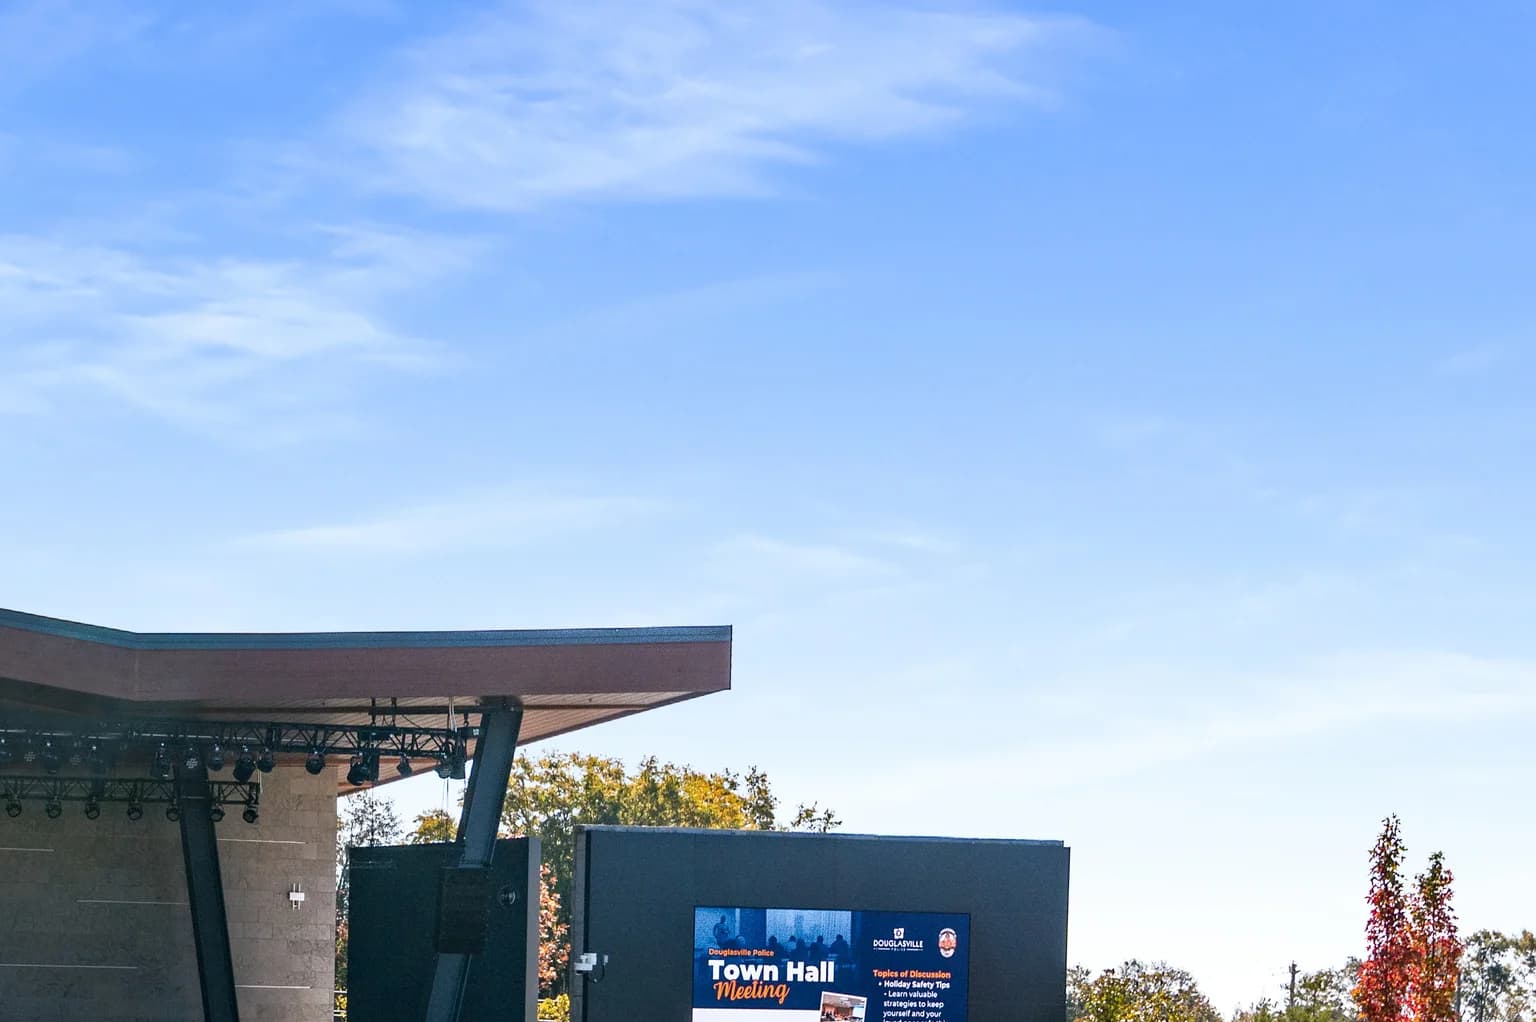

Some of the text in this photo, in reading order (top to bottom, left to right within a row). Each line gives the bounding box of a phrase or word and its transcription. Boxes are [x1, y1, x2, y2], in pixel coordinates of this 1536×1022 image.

[873, 939, 923, 948] DOUGLASVILLE
[708, 948, 774, 957] Douglasville Police
[708, 959, 835, 982] Town Hall
[873, 969, 898, 978] Topics
[910, 970, 951, 978] Discussion
[884, 980, 950, 990] Holiday Safety Tips
[713, 979, 790, 1005] Meeting
[884, 1000, 917, 1008] strategies
[927, 1001, 944, 1009] keep
[883, 1010, 911, 1018] yourself
